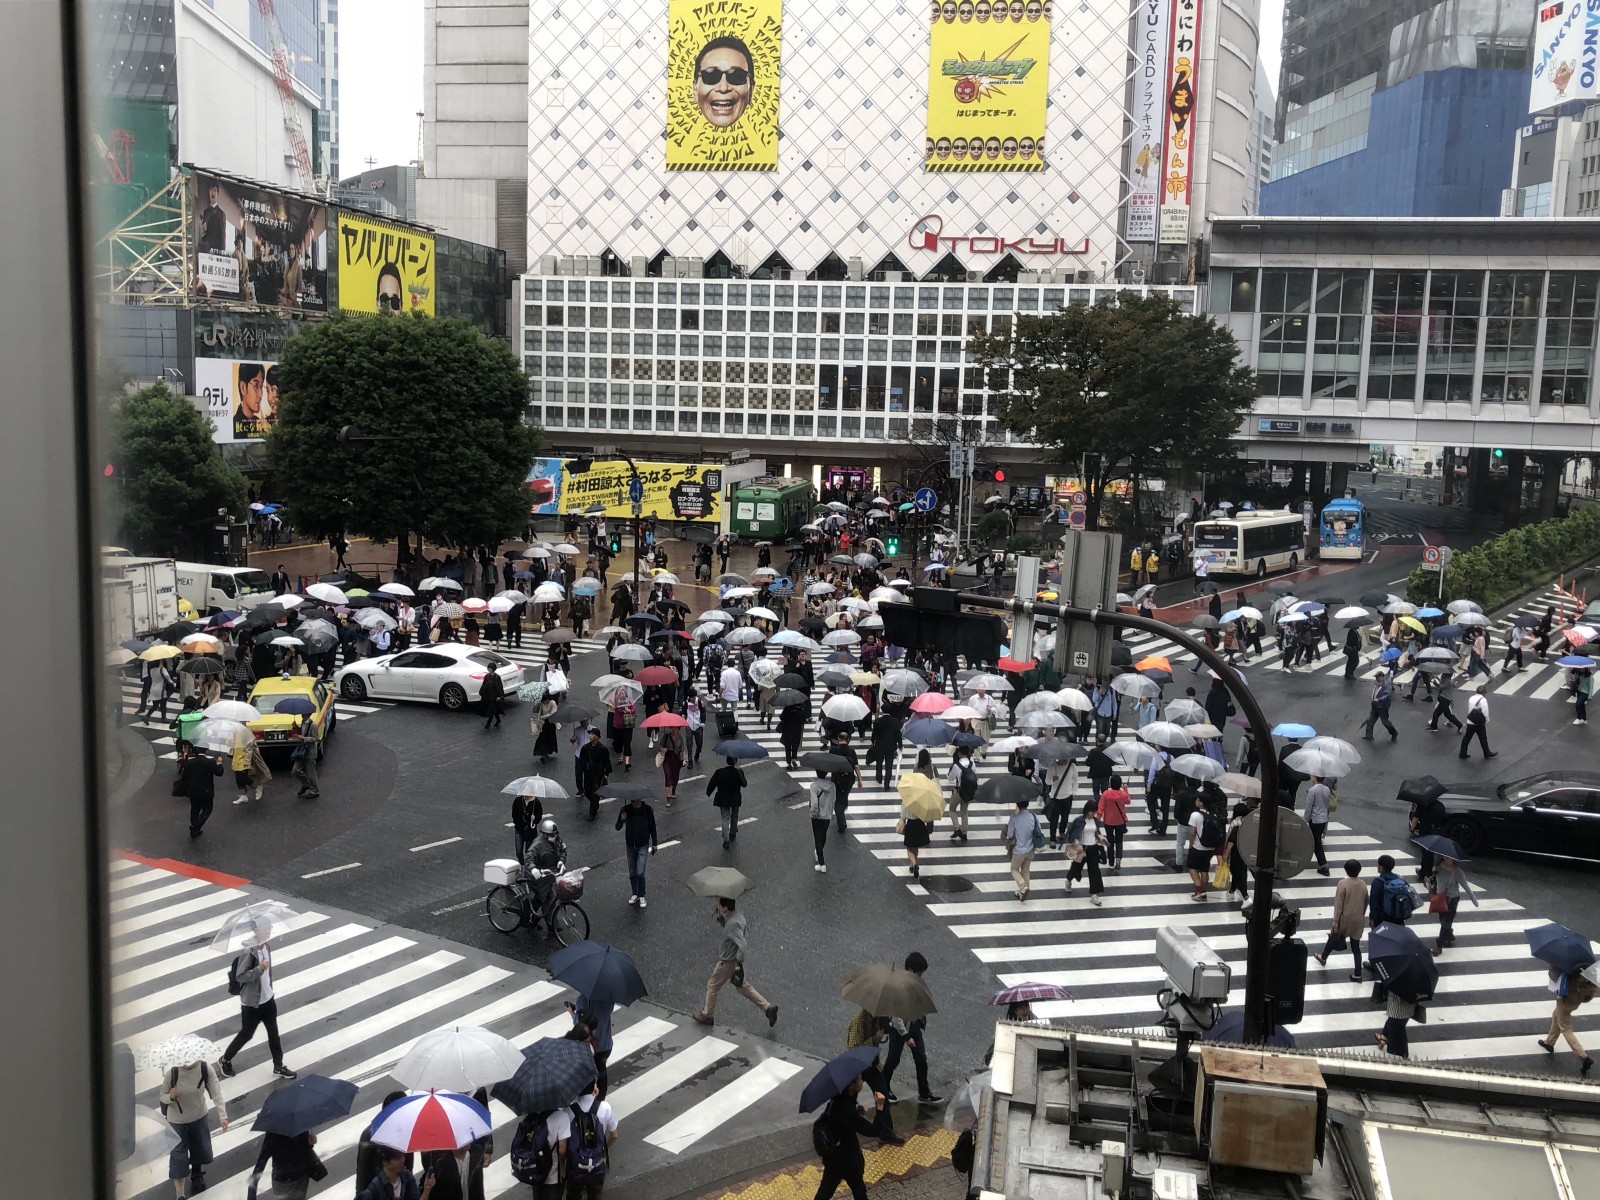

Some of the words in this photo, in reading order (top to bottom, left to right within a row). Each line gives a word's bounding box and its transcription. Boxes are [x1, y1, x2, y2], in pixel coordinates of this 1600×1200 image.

[1145, 30, 1157, 78] CARD
[956, 109, 1017, 117] はじまってまーす。
[938, 235, 1090, 255] TOKYU
[303, 293, 323, 305] SoftBank
[203, 324, 228, 347] JR
[177, 578, 194, 586] MEAT
